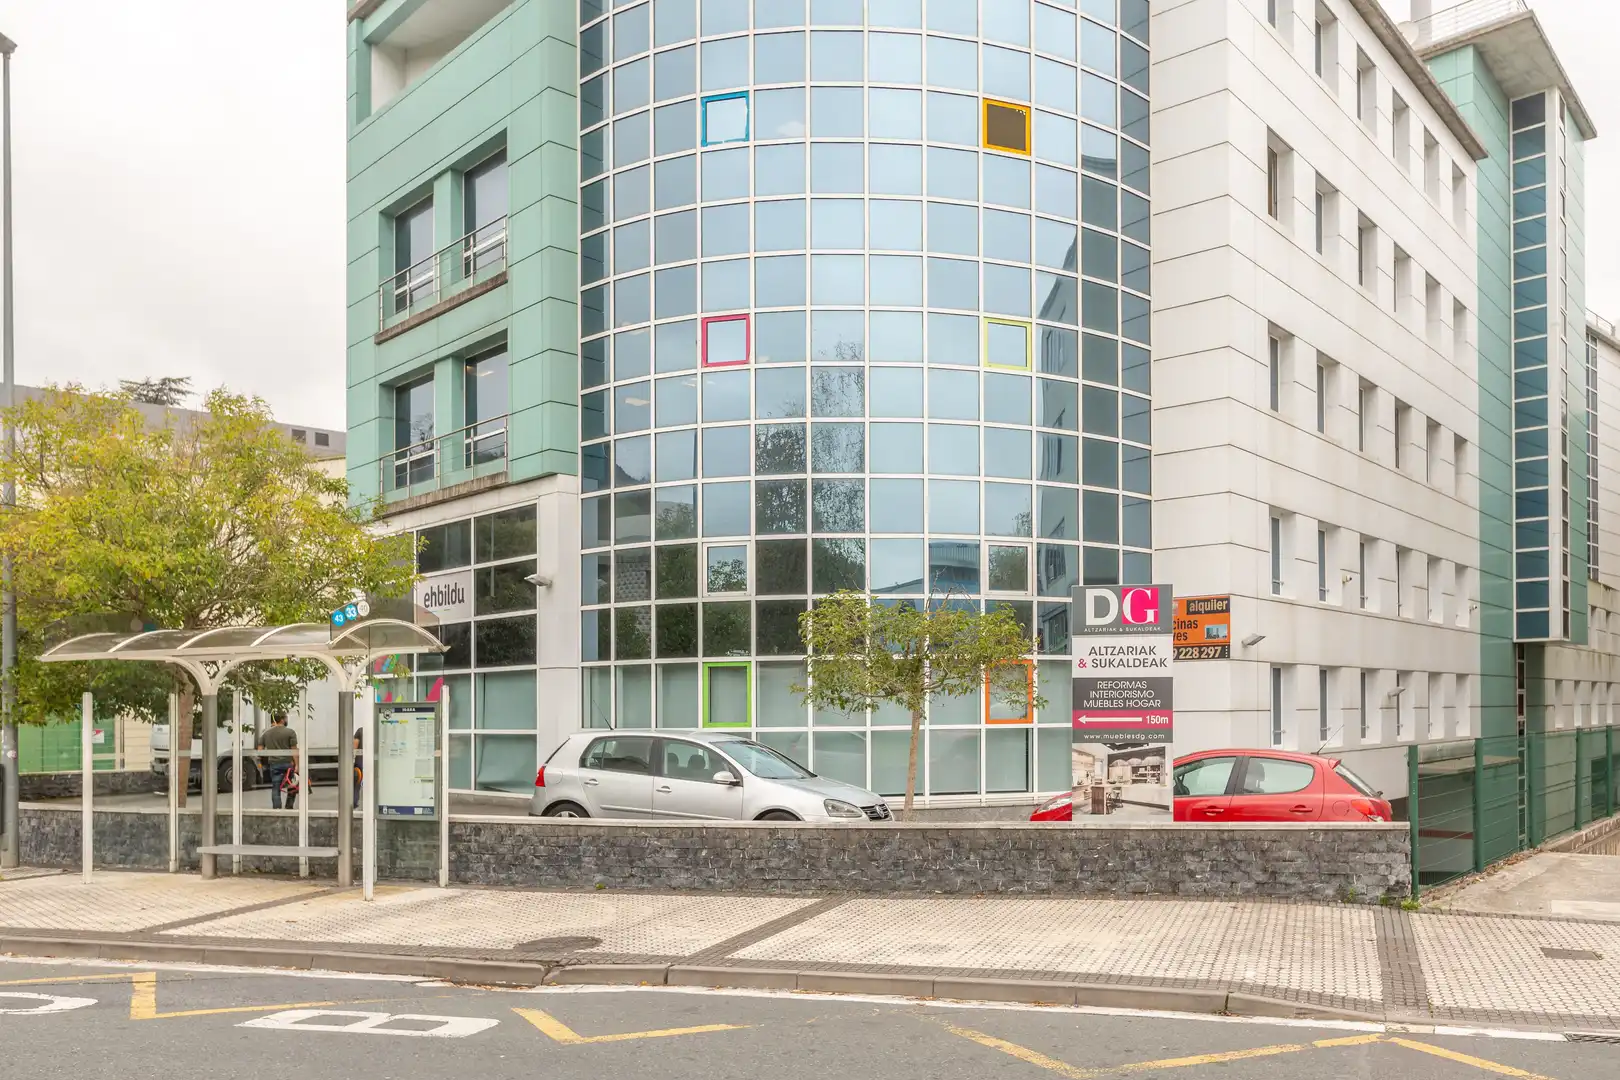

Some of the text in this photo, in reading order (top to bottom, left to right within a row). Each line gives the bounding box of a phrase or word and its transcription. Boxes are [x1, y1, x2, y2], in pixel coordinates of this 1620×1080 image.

[424, 582, 465, 608] ehbildu
[1086, 588, 1159, 625] DG
[1189, 599, 1228, 613] alquiler
[334, 614, 343, 622] 43
[345, 607, 356, 618] 33
[1088, 646, 1157, 656] ALTZARIAK
[1179, 647, 1200, 659] 228
[1200, 646, 1222, 658] 297
[1077, 658, 1168, 668] & SUKALDEAK
[1097, 681, 1147, 689] REFORMAS
[1089, 690, 1155, 698] INTERIORISMO
[1083, 699, 1161, 708] MUEBLES HOGAR
[1145, 715, 1169, 724] 150m
[1083, 732, 1165, 740] www.mueblesdg.com
